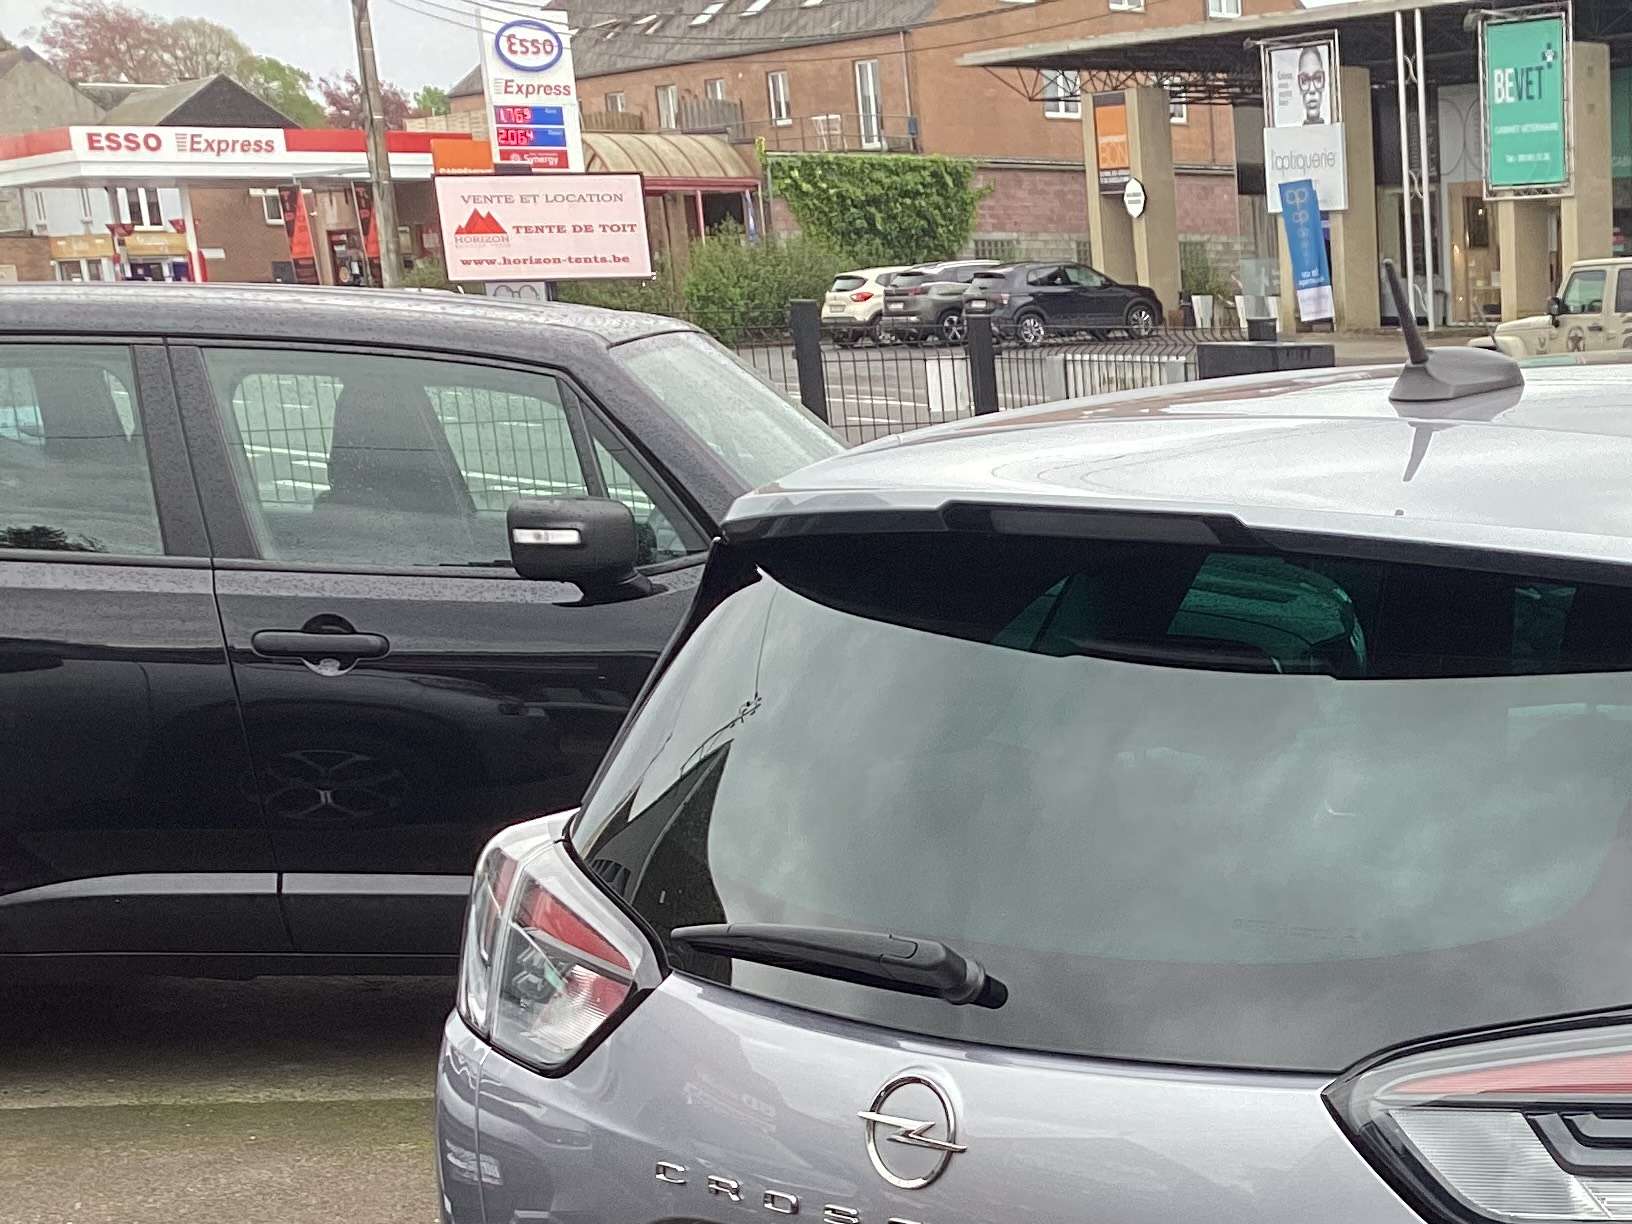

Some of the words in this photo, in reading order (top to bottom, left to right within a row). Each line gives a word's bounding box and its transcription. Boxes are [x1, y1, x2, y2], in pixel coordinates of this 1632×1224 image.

[503, 79, 571, 97] Express
[1493, 66, 1544, 104] BEVET
[86, 132, 163, 152] ESSO
[189, 133, 275, 157] Express
[461, 194, 515, 204] VENTE
[520, 194, 539, 204] ET
[544, 193, 624, 203] LOCATION
[512, 224, 567, 234] TENTE
[572, 224, 595, 234] DE
[599, 223, 637, 233] TOIT
[455, 235, 510, 244] HORIZON
[460, 254, 630, 266] www.horizon-tents.be
